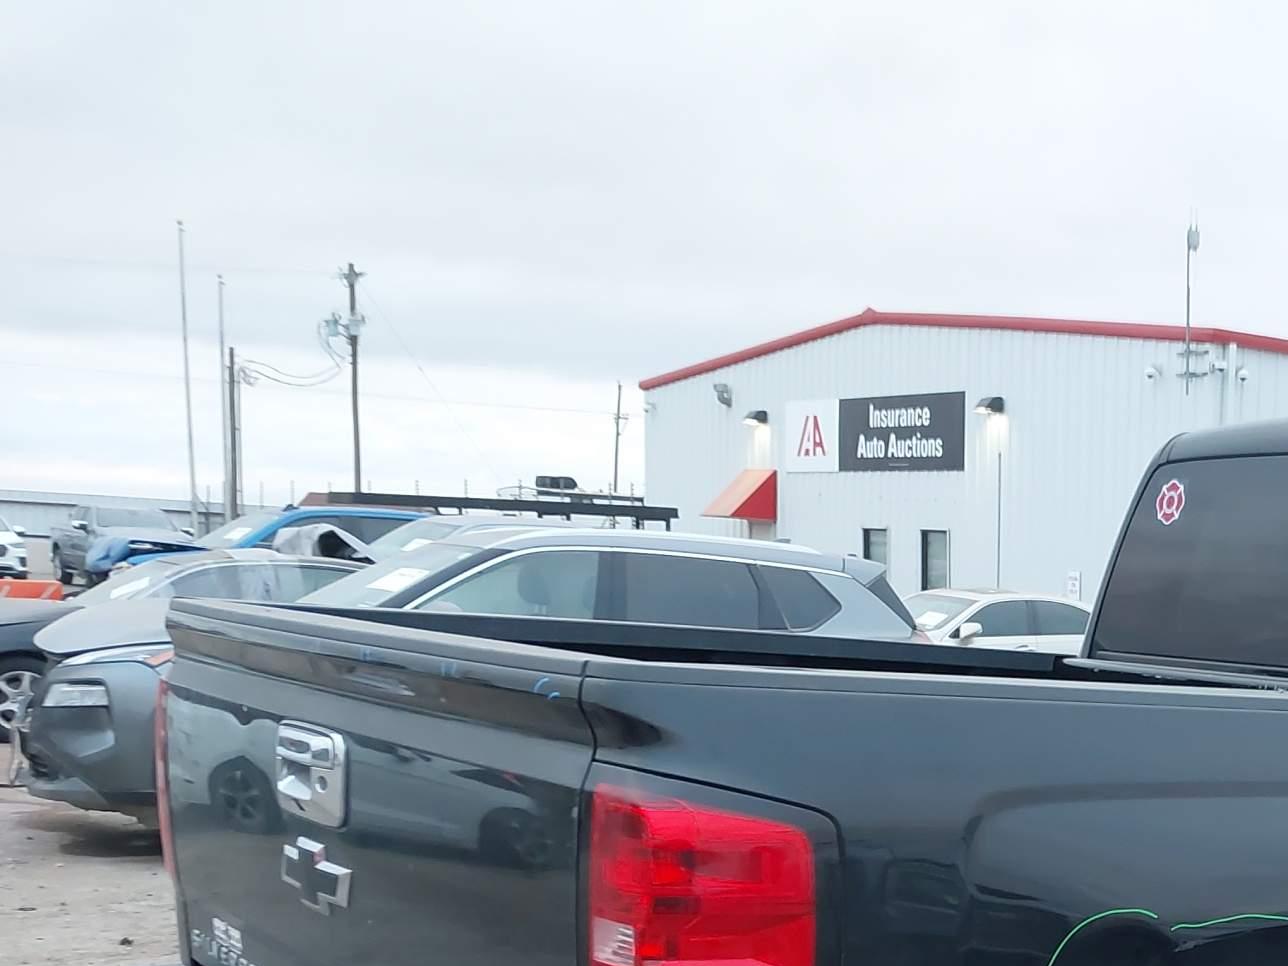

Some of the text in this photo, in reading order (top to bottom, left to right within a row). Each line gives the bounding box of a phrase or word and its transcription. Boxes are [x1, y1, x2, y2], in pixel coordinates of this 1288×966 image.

[868, 403, 931, 428] Insurance
[856, 431, 943, 459] Auto Auctions
